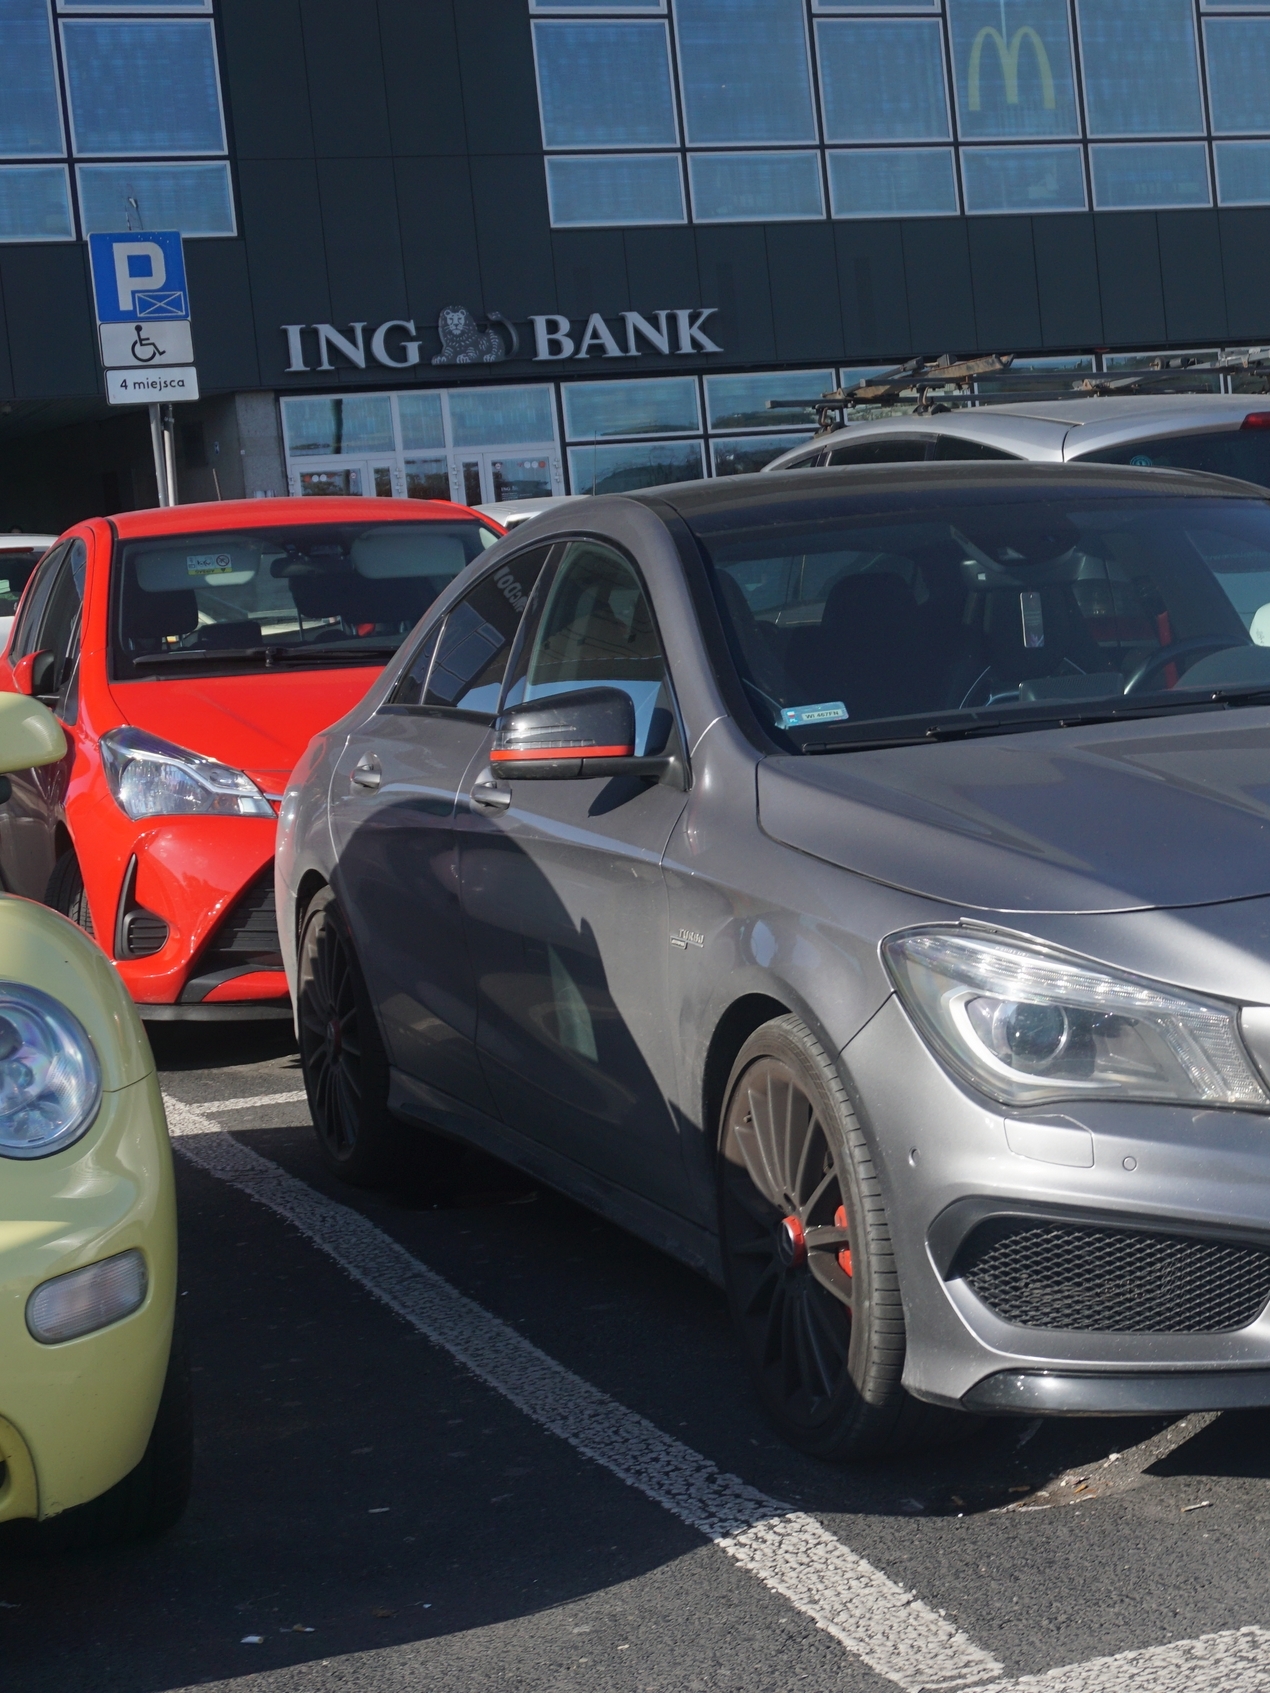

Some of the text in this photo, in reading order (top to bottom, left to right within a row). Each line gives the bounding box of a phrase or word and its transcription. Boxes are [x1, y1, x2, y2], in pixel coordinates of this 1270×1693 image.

[112, 241, 167, 311] P
[280, 307, 724, 372] ING BANK
[120, 376, 185, 392] 4 miejsca
